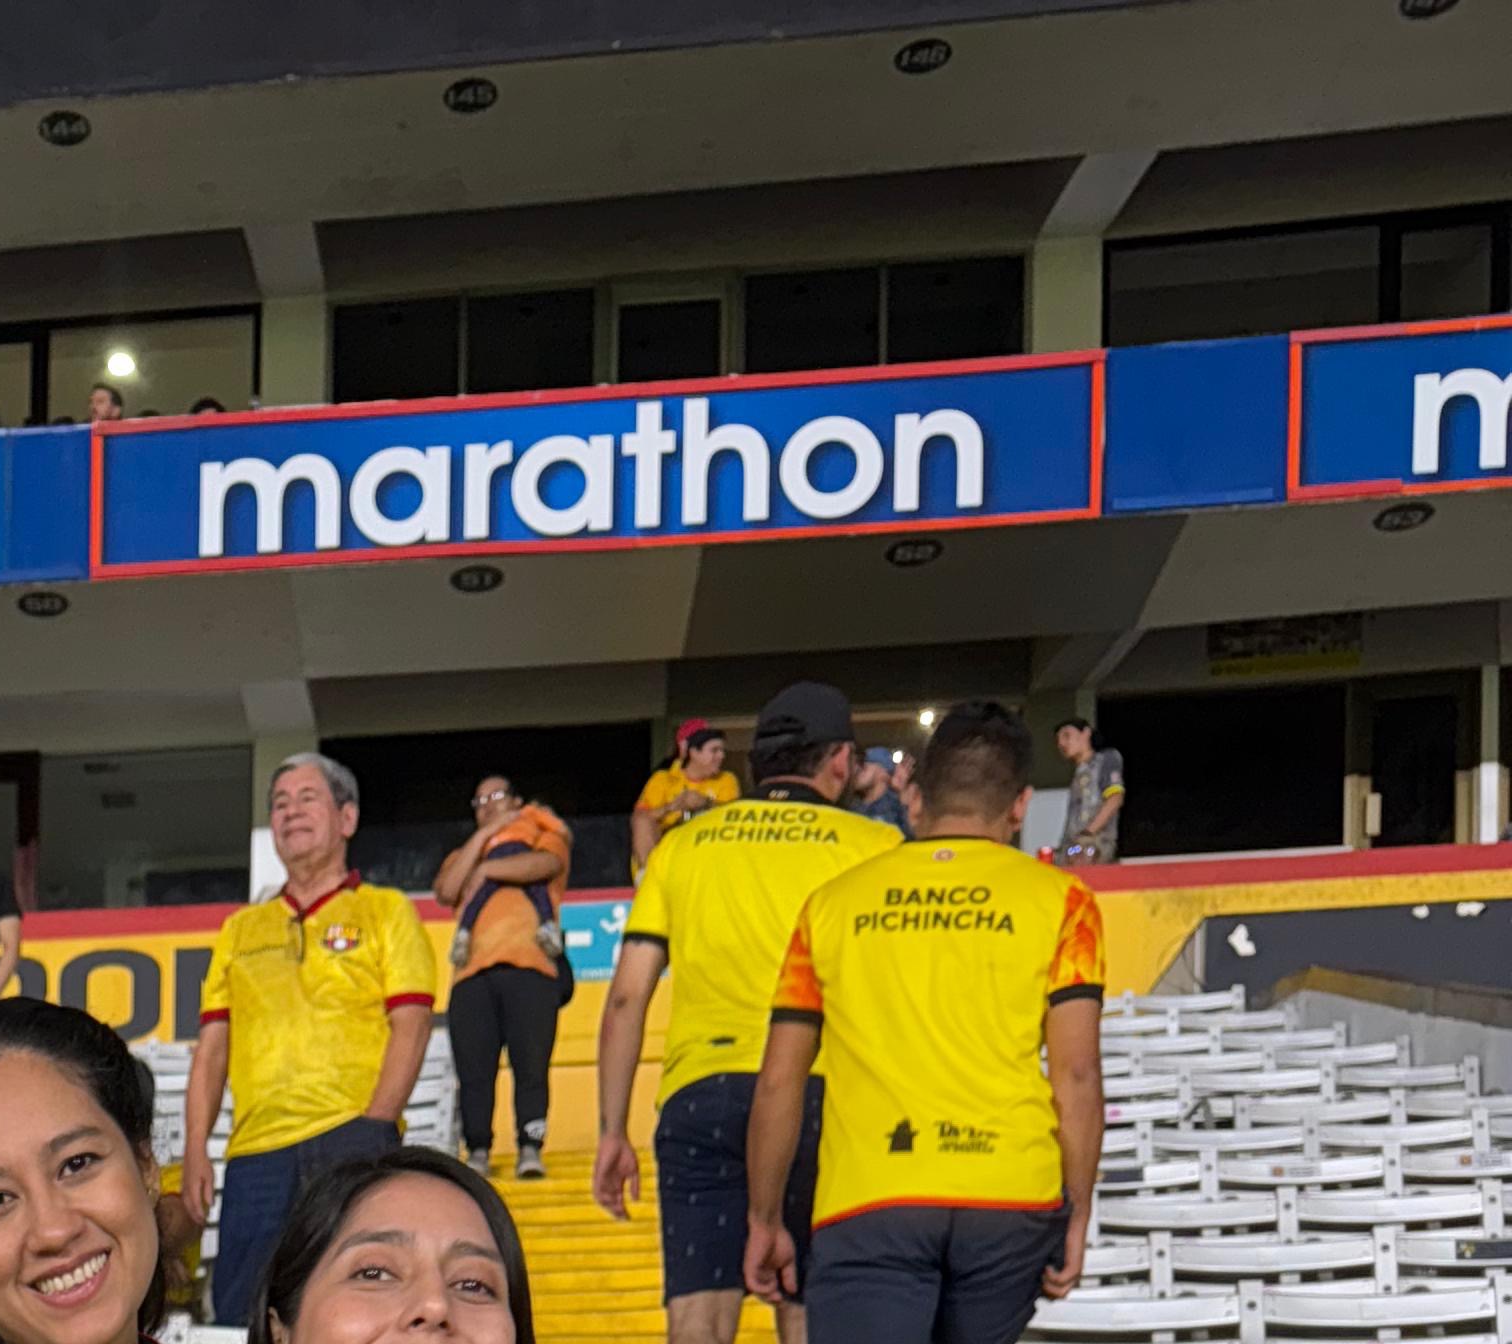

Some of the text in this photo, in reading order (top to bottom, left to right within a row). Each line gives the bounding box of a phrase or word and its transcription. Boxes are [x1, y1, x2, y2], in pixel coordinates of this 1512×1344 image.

[198, 396, 985, 559] marathon
[724, 808, 818, 824] BANCO
[695, 826, 840, 846] PICHINCHA
[885, 886, 991, 907] BANCO
[854, 910, 1015, 936] PICHINCHA
